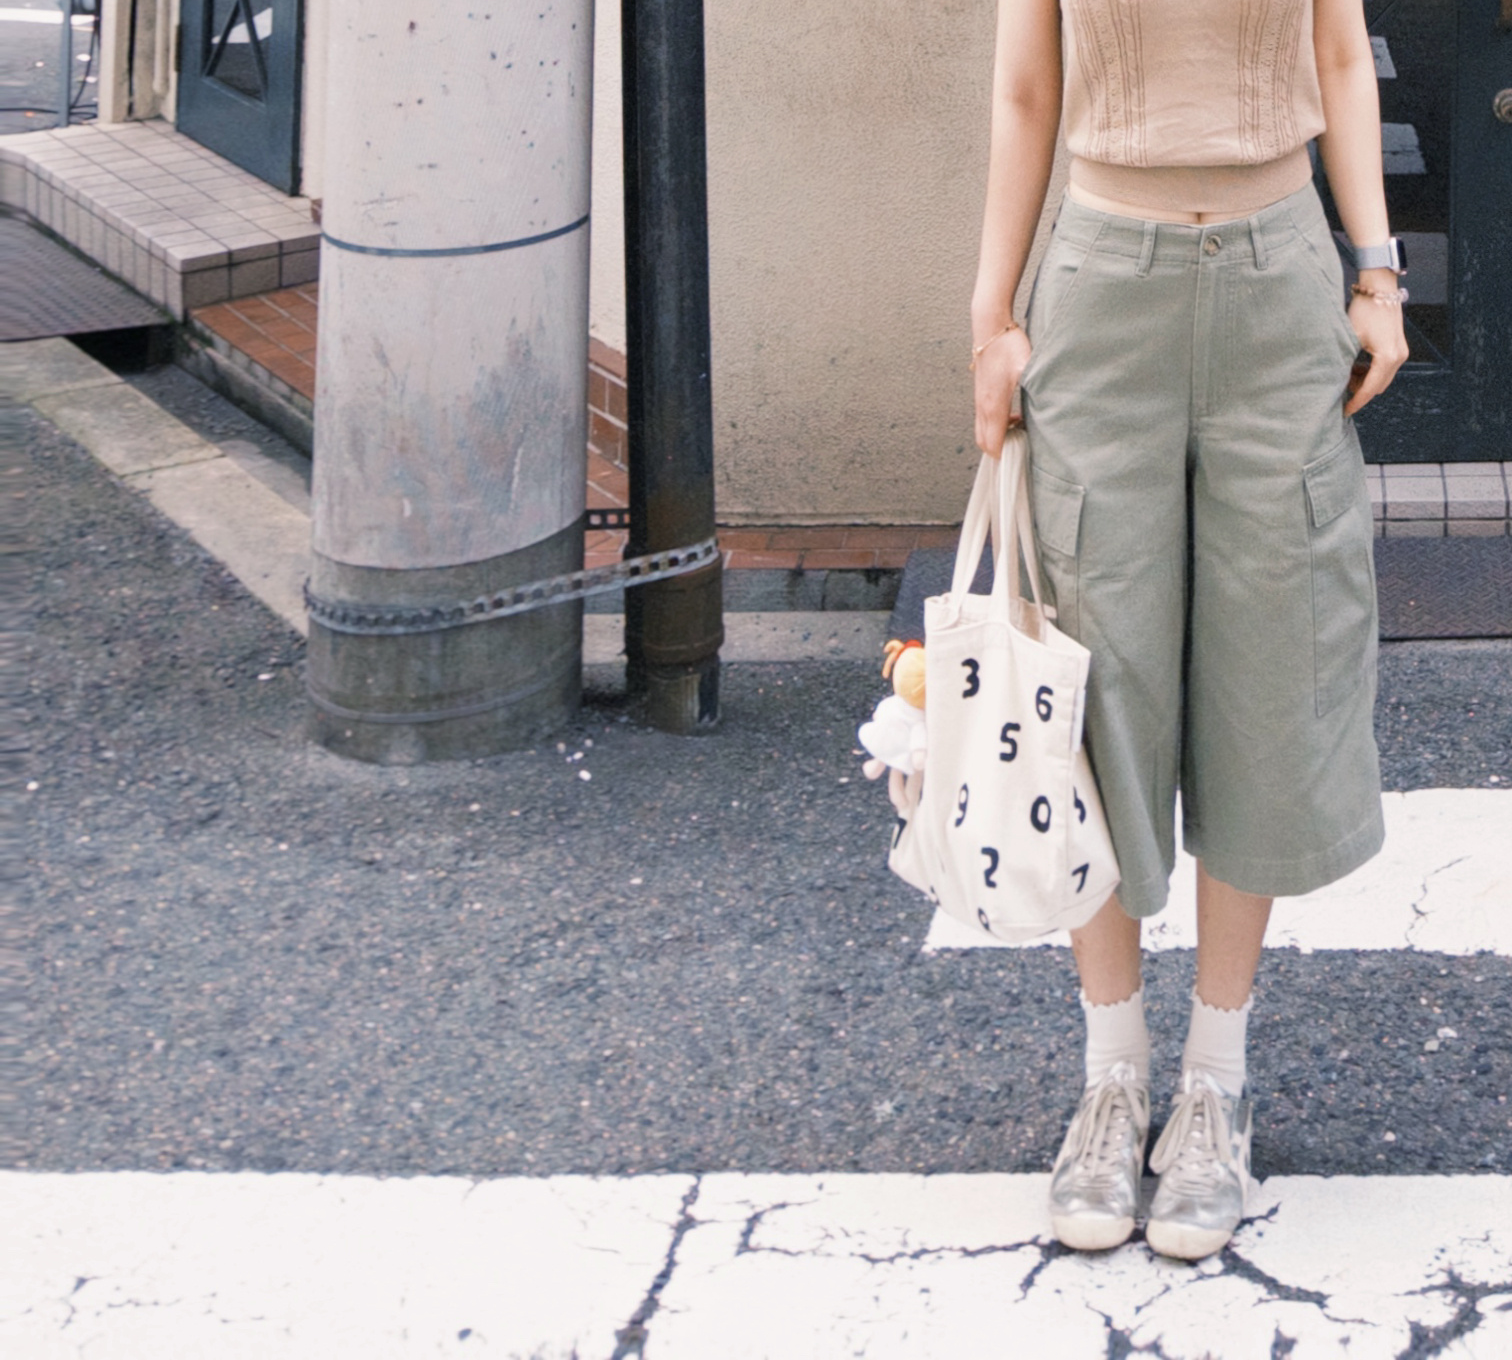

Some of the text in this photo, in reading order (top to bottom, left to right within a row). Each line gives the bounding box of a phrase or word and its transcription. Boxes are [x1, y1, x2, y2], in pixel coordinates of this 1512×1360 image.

[961, 658, 980, 699] 3
[1035, 686, 1053, 722] 6
[1000, 722, 1021, 762] 5
[1030, 795, 1051, 834] 0
[1072, 862, 1090, 894] 7
